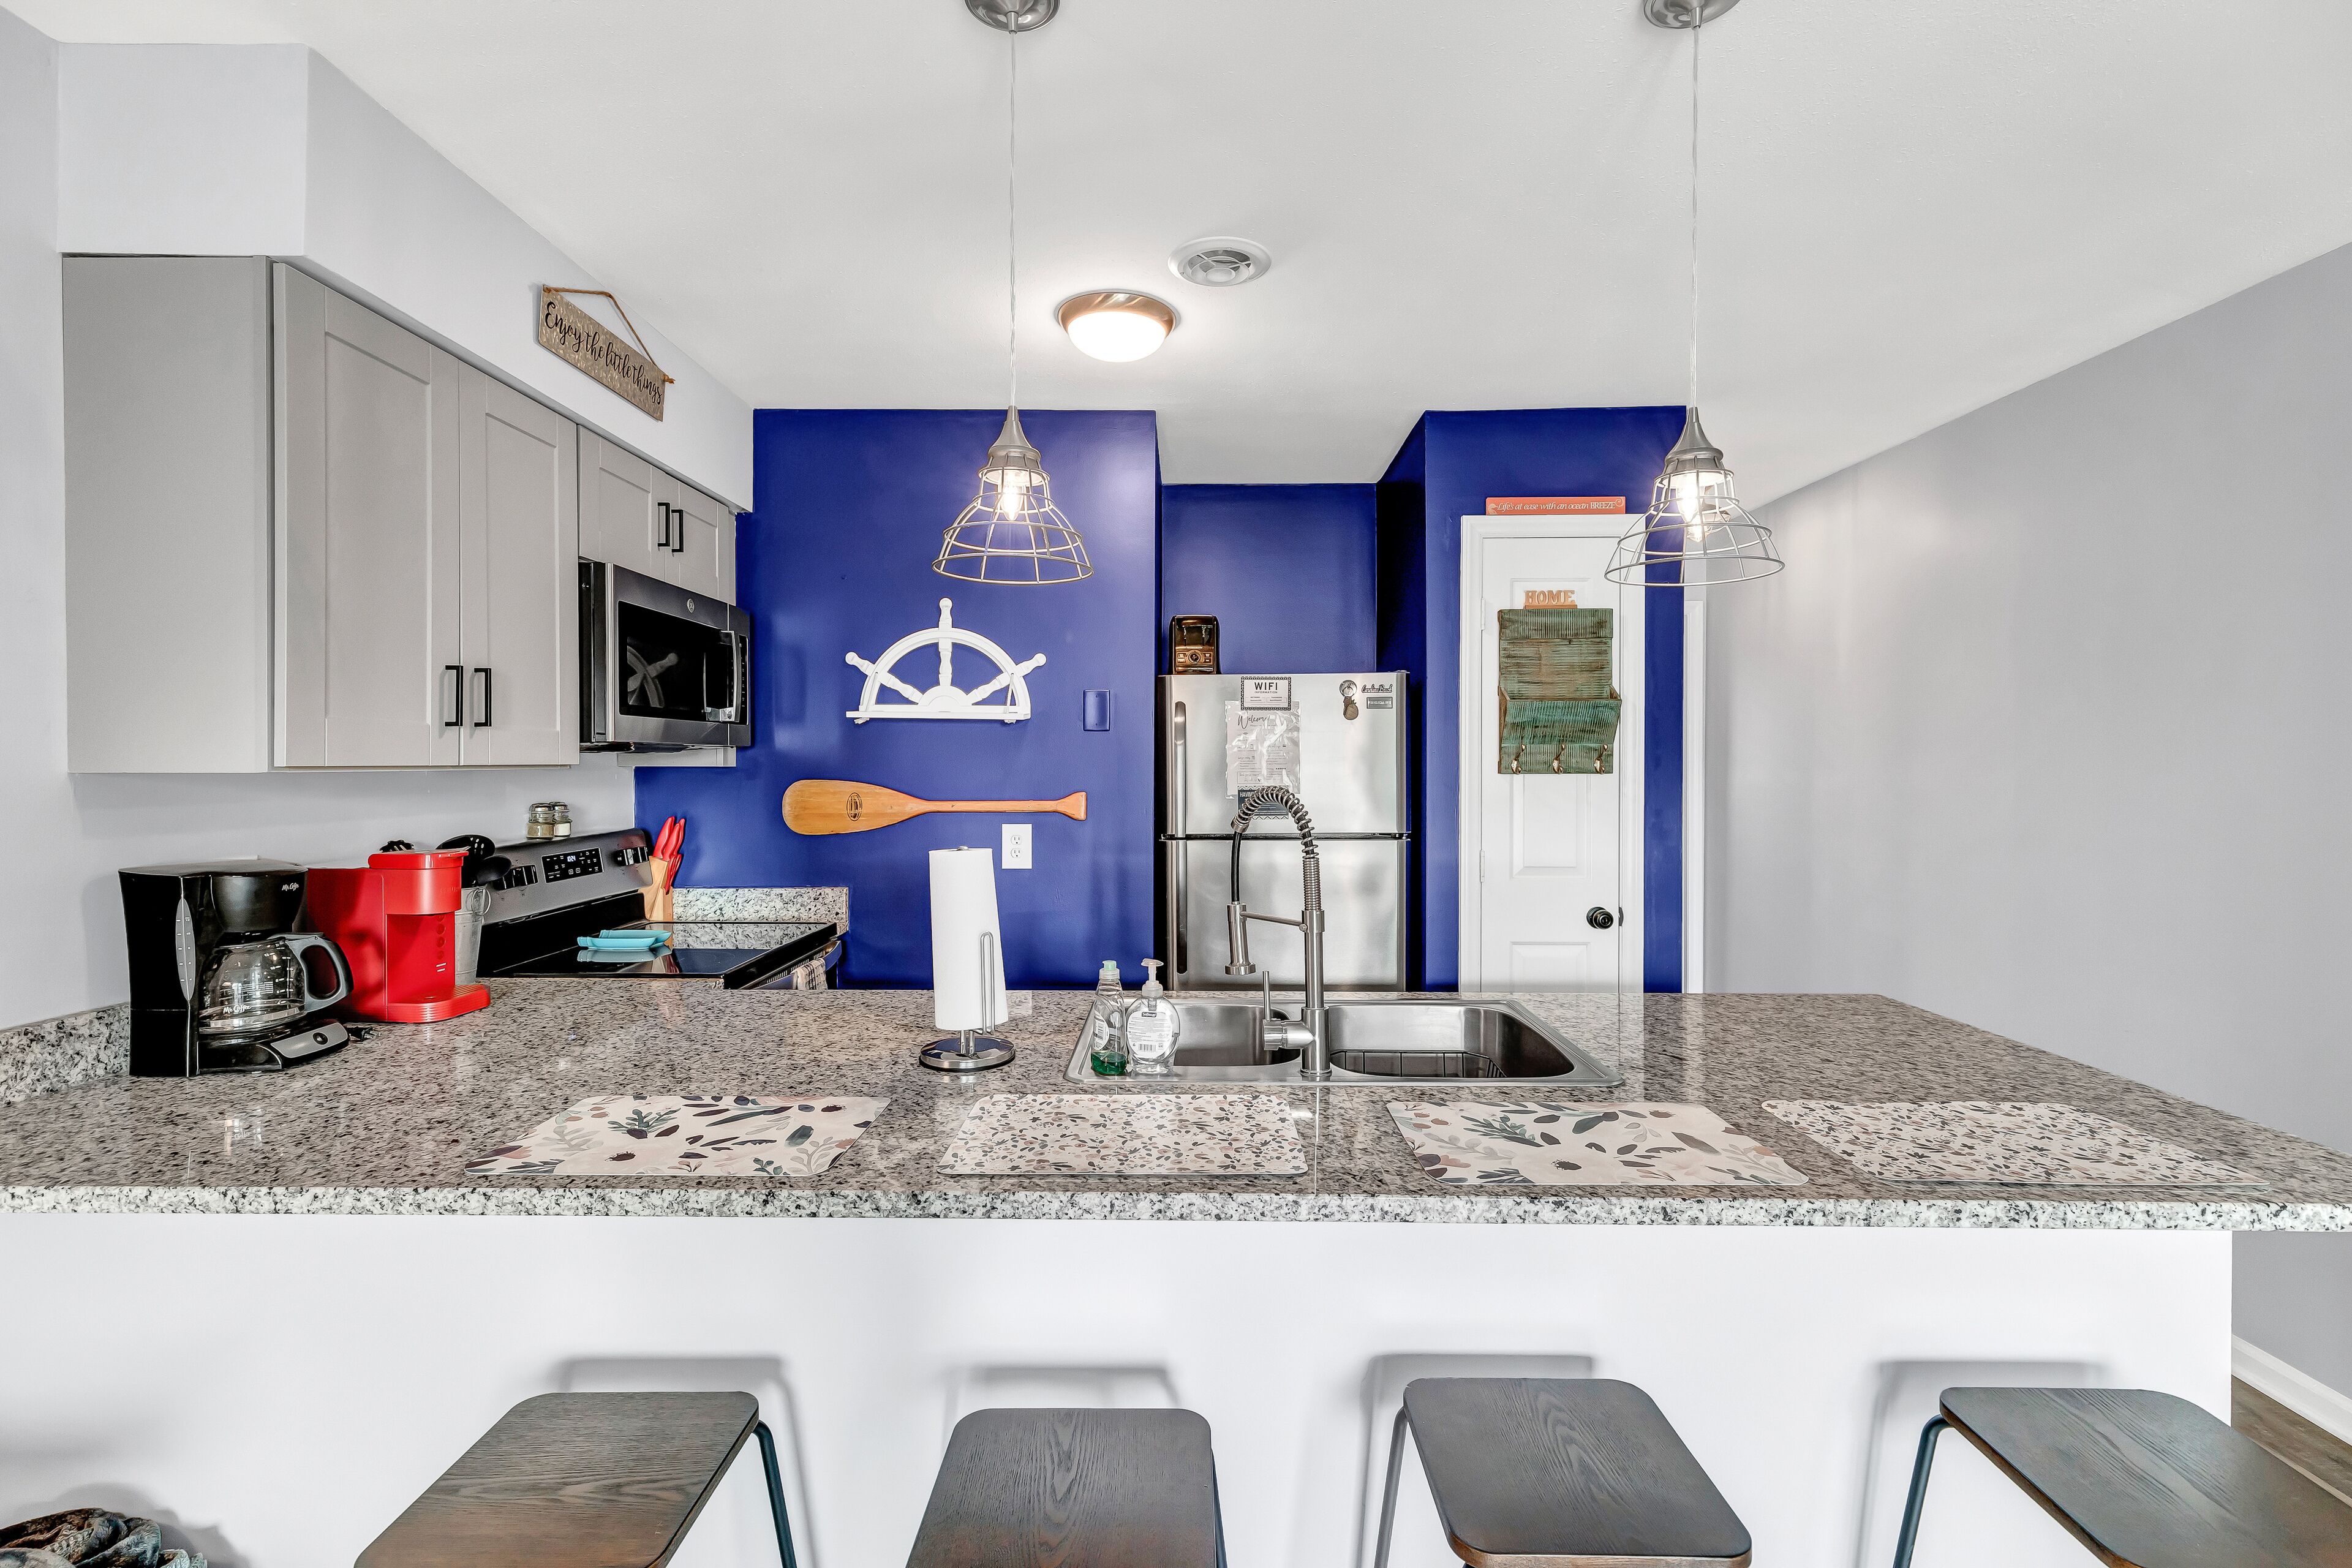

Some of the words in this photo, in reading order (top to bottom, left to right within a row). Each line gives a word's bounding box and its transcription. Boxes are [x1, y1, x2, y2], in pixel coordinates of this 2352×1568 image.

[545, 300, 585, 353] Enjoy
[584, 330, 605, 362] the
[605, 342, 631, 379] little
[631, 364, 663, 405] things
[1497, 502, 1514, 513] Life's
[1540, 502, 1556, 510] with
[1523, 589, 1577, 605] HOME
[1254, 682, 1278, 690] WIFI
[233, 1004, 252, 1014] Coffee
